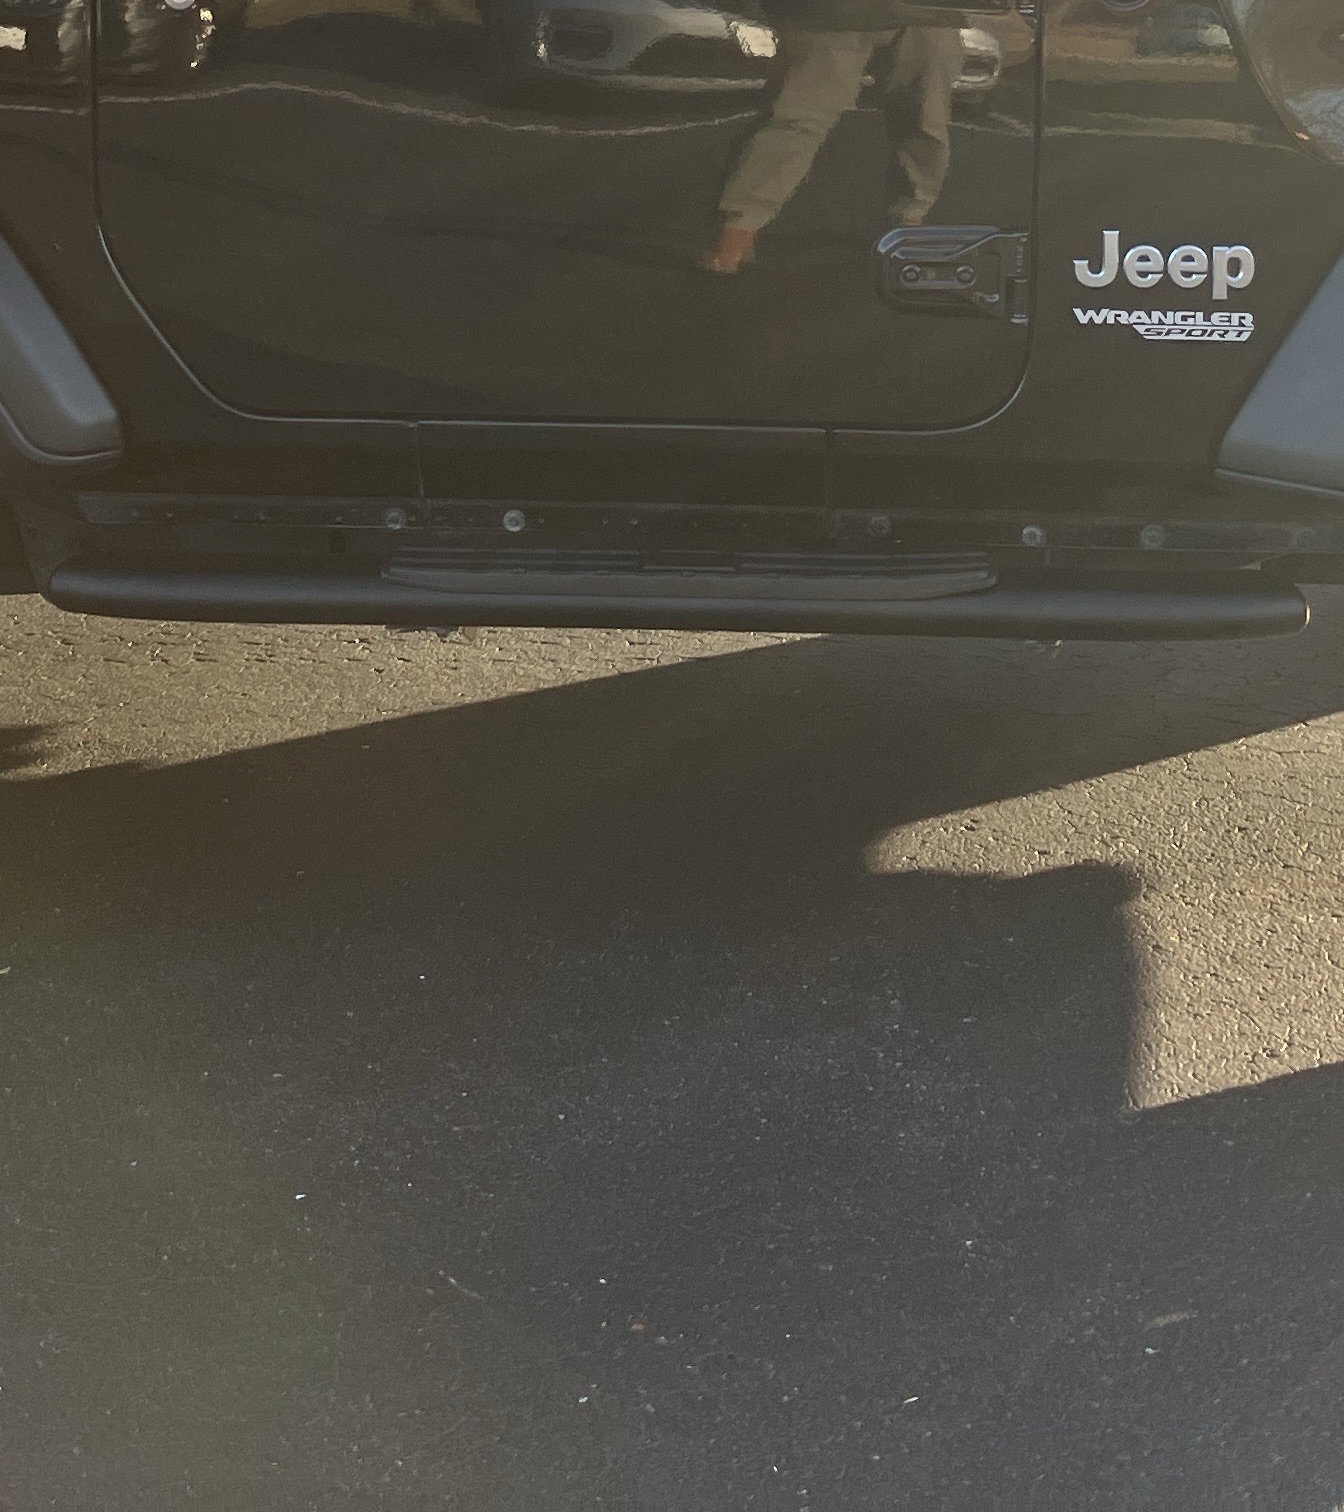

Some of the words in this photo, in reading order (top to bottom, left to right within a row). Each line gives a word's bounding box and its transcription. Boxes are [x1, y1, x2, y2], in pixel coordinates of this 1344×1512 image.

[1072, 229, 1256, 301] Jeep
[1072, 306, 1256, 328] WRANGLER
[1142, 326, 1250, 339] SPORT
